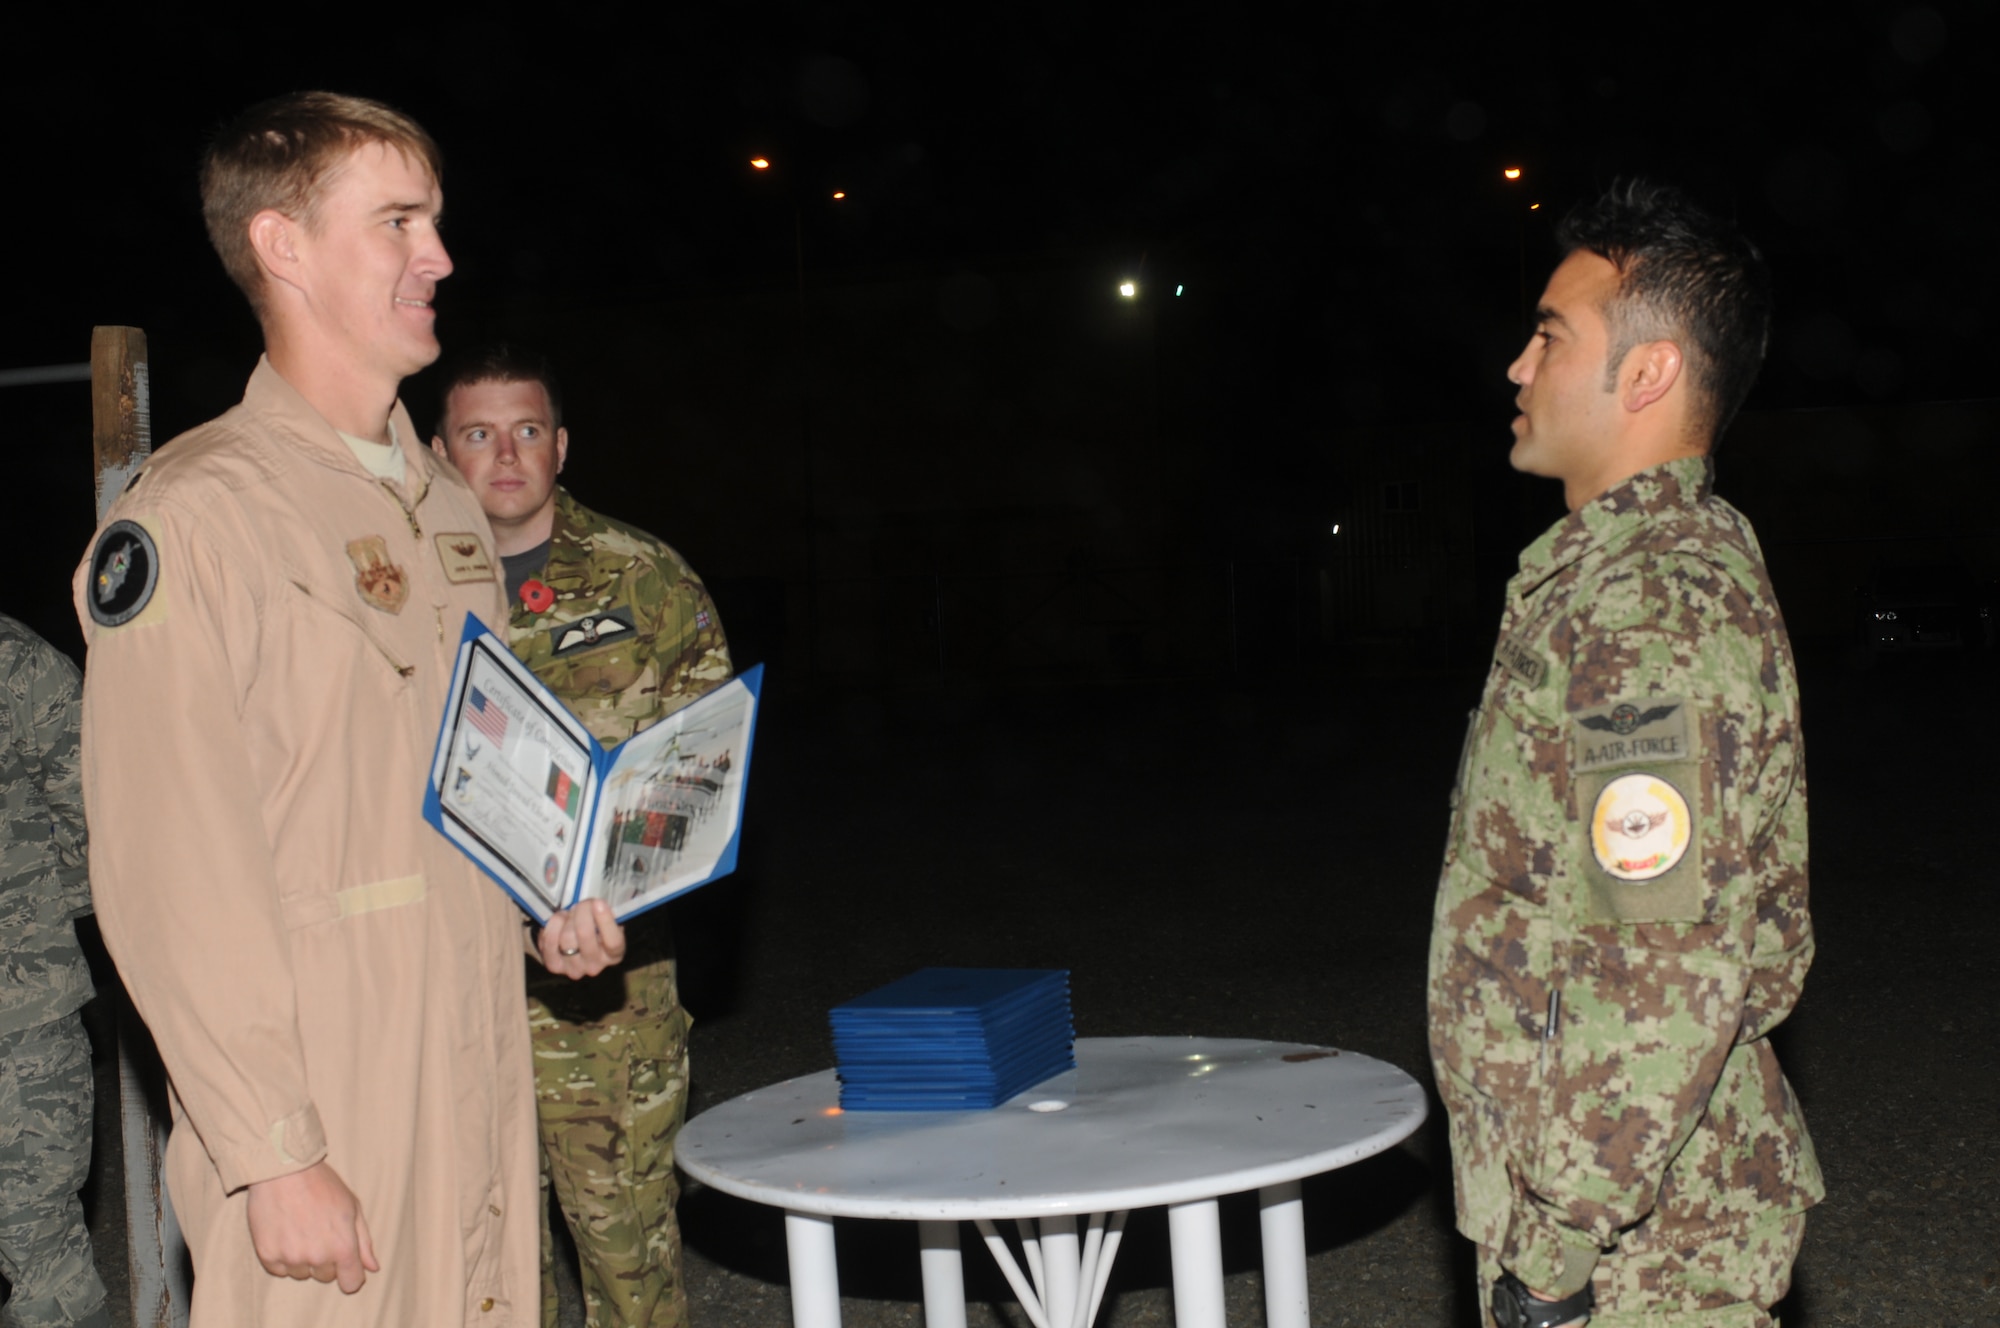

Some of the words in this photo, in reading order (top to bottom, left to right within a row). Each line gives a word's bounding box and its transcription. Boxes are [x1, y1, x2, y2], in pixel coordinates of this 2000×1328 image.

[483, 679, 525, 724] Certificate
[524, 719, 537, 737] of
[1584, 735, 1680, 766] A-AIR-FORCE
